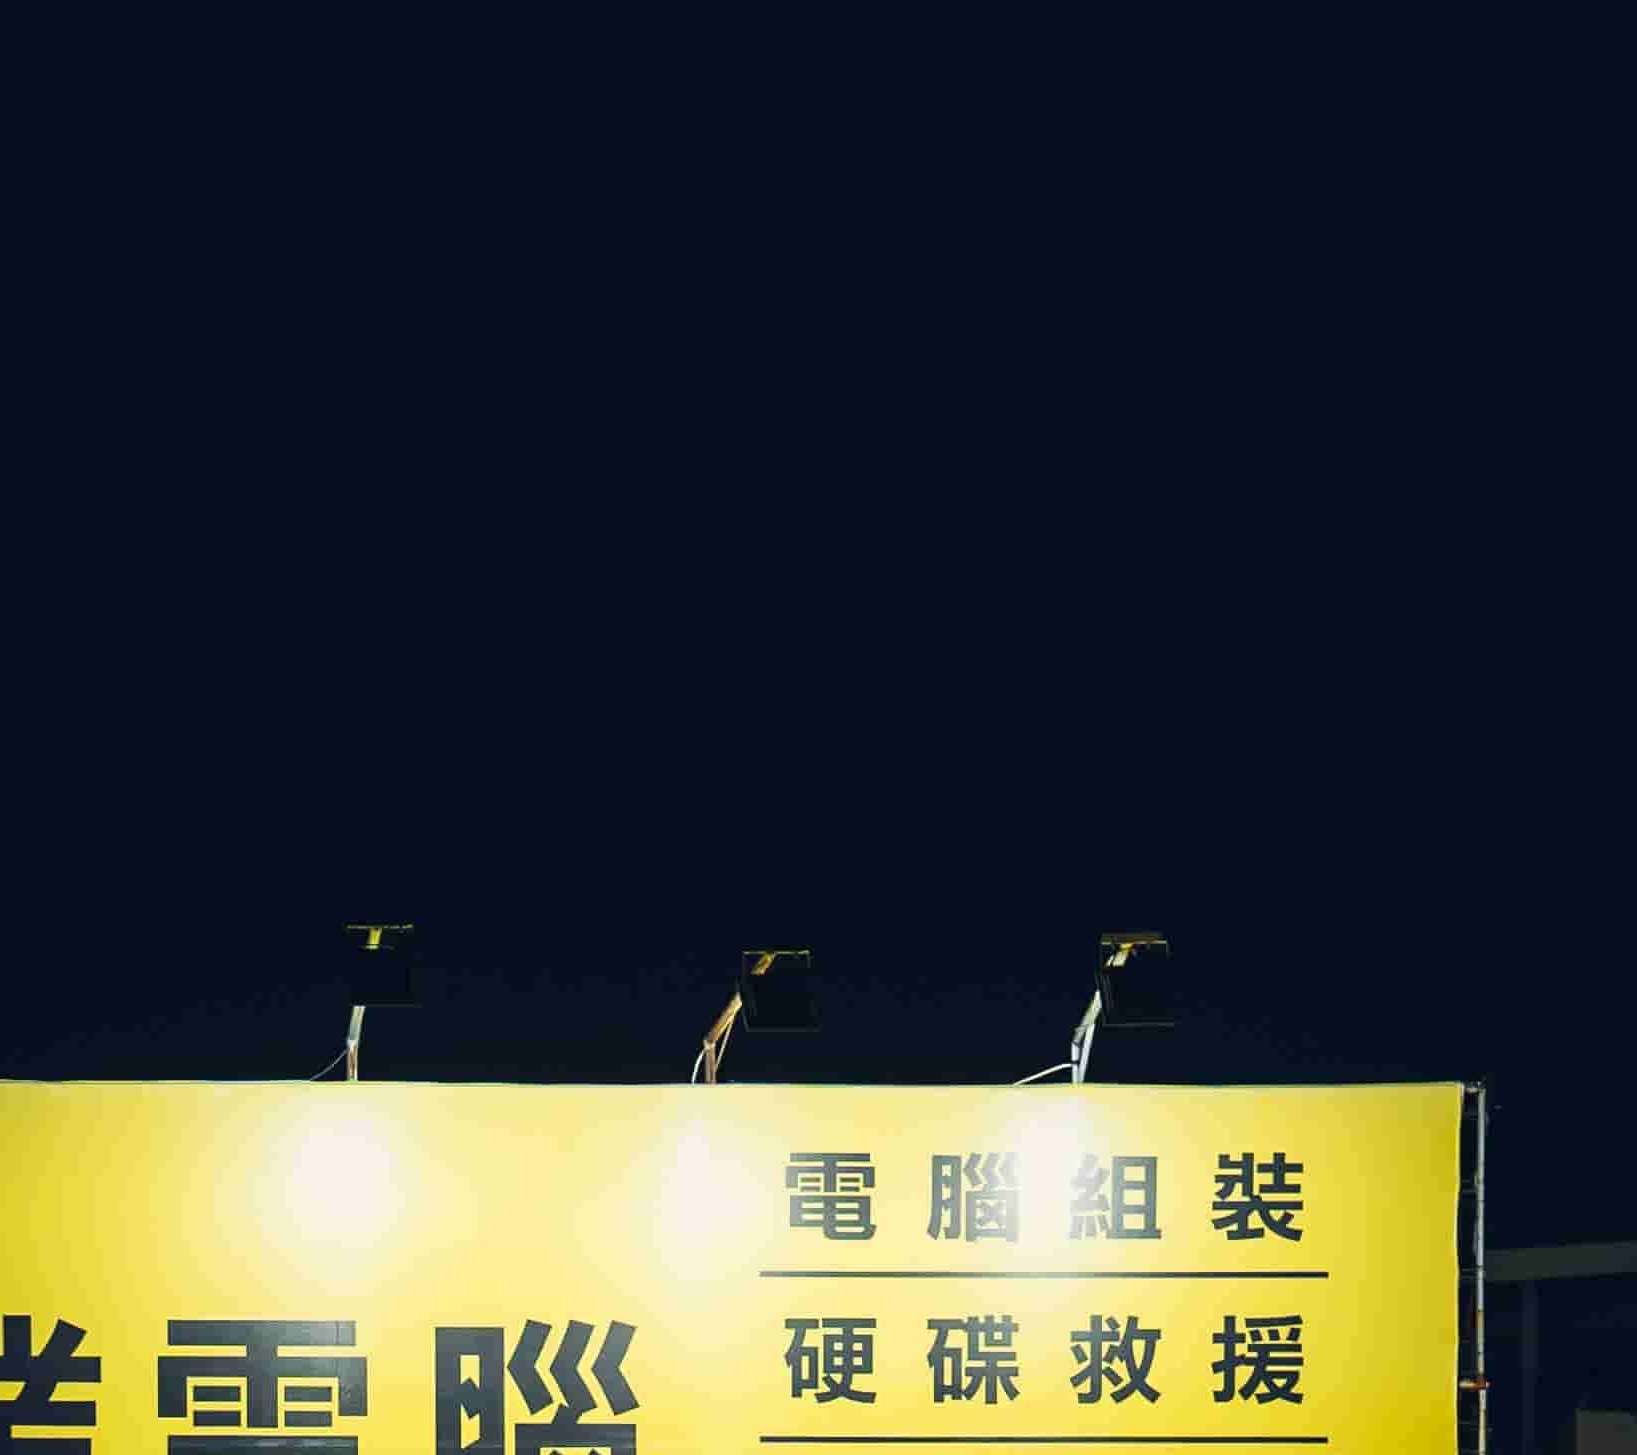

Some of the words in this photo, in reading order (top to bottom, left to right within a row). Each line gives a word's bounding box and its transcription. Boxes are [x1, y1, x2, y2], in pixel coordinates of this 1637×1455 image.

[784, 1152, 1305, 1242] 電腦組裝
[784, 1315, 1305, 1404] 硬碟救援
